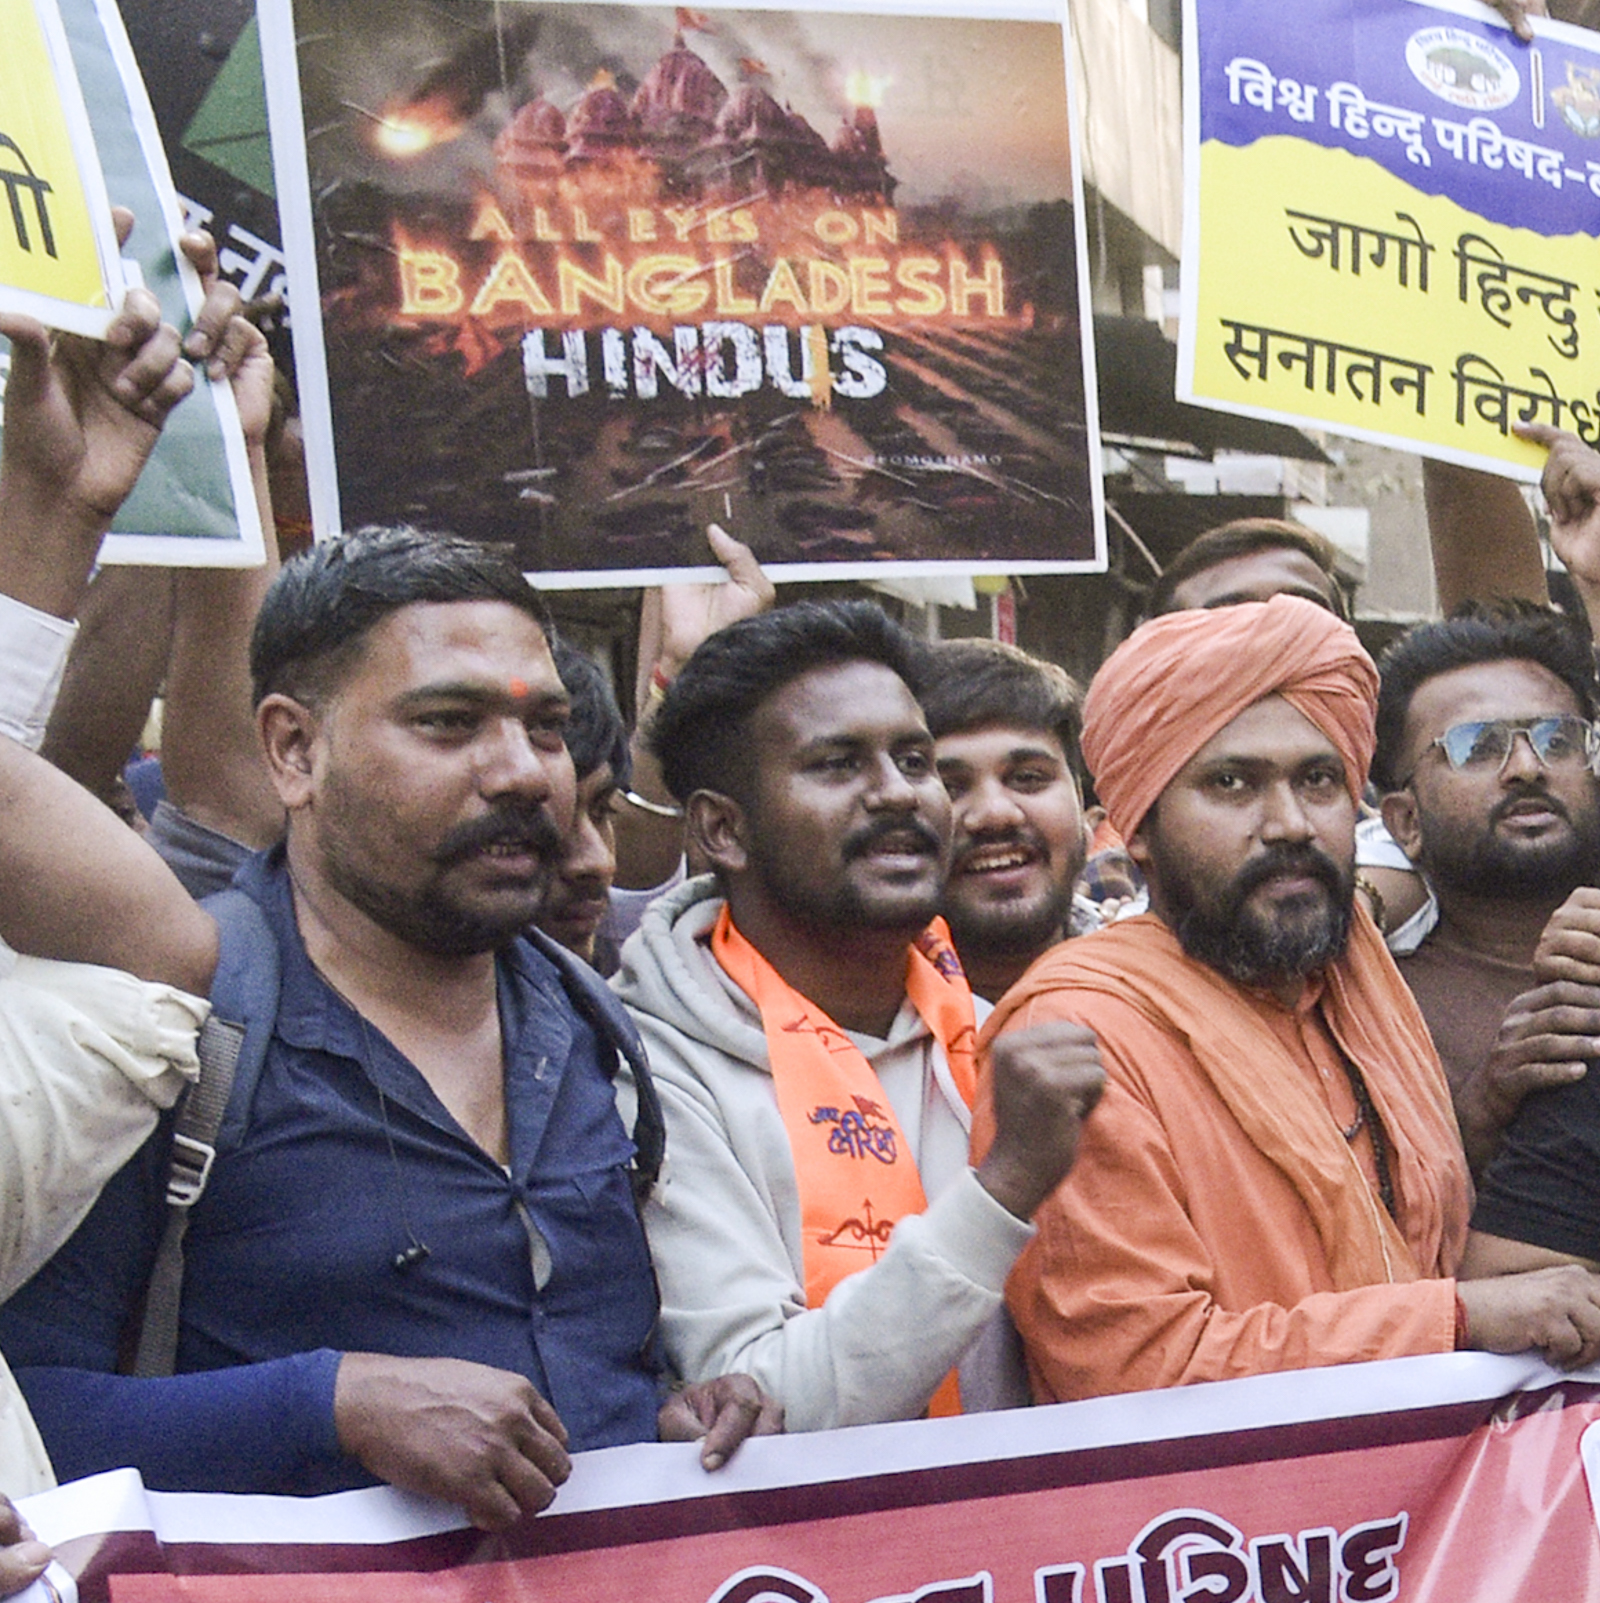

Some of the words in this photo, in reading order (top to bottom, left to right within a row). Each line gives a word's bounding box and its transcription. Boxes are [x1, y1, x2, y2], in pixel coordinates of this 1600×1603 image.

[1225, 57, 1317, 122] विश्व
[1325, 80, 1433, 169] हिन्दू
[470, 206, 601, 244] ALL
[629, 205, 758, 242] EYES
[813, 207, 899, 243] ON
[399, 250, 1006, 318] BANGLADESH
[1285, 208, 1435, 296] जागो
[1452, 232, 1580, 361] हिन्दु
[519, 320, 887, 399] HINDUS
[1220, 318, 1433, 415] सनातन
